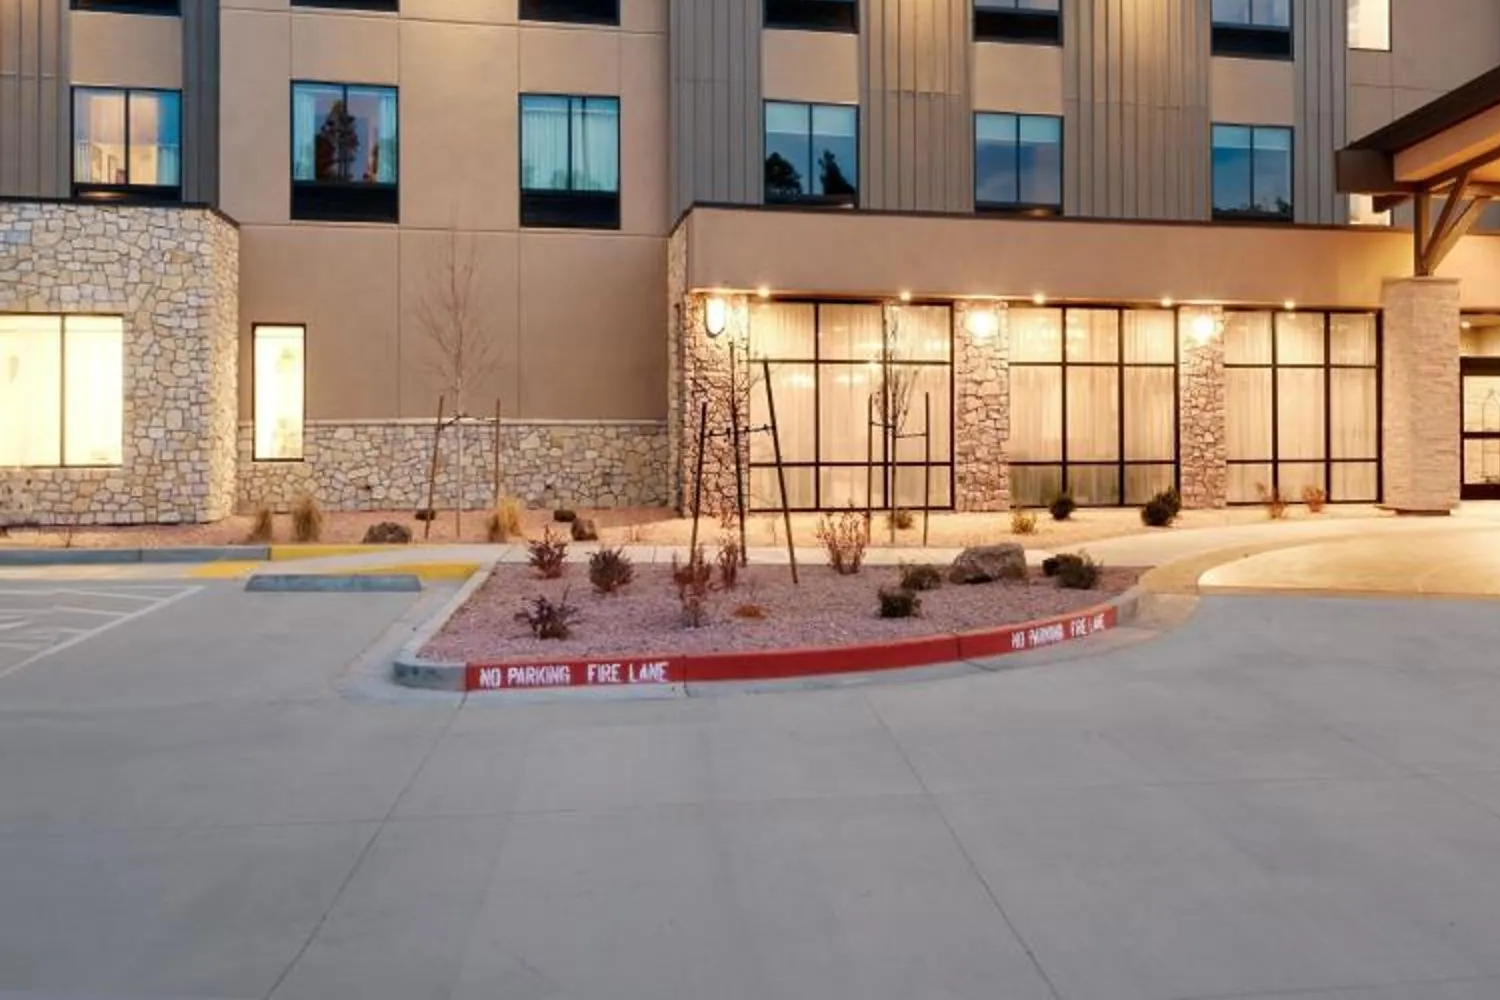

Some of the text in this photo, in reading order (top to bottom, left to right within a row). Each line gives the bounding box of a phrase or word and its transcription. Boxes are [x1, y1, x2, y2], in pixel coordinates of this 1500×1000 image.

[1011, 631, 1025, 649] NO
[480, 662, 669, 687] NO PARKING FIRE LANE
